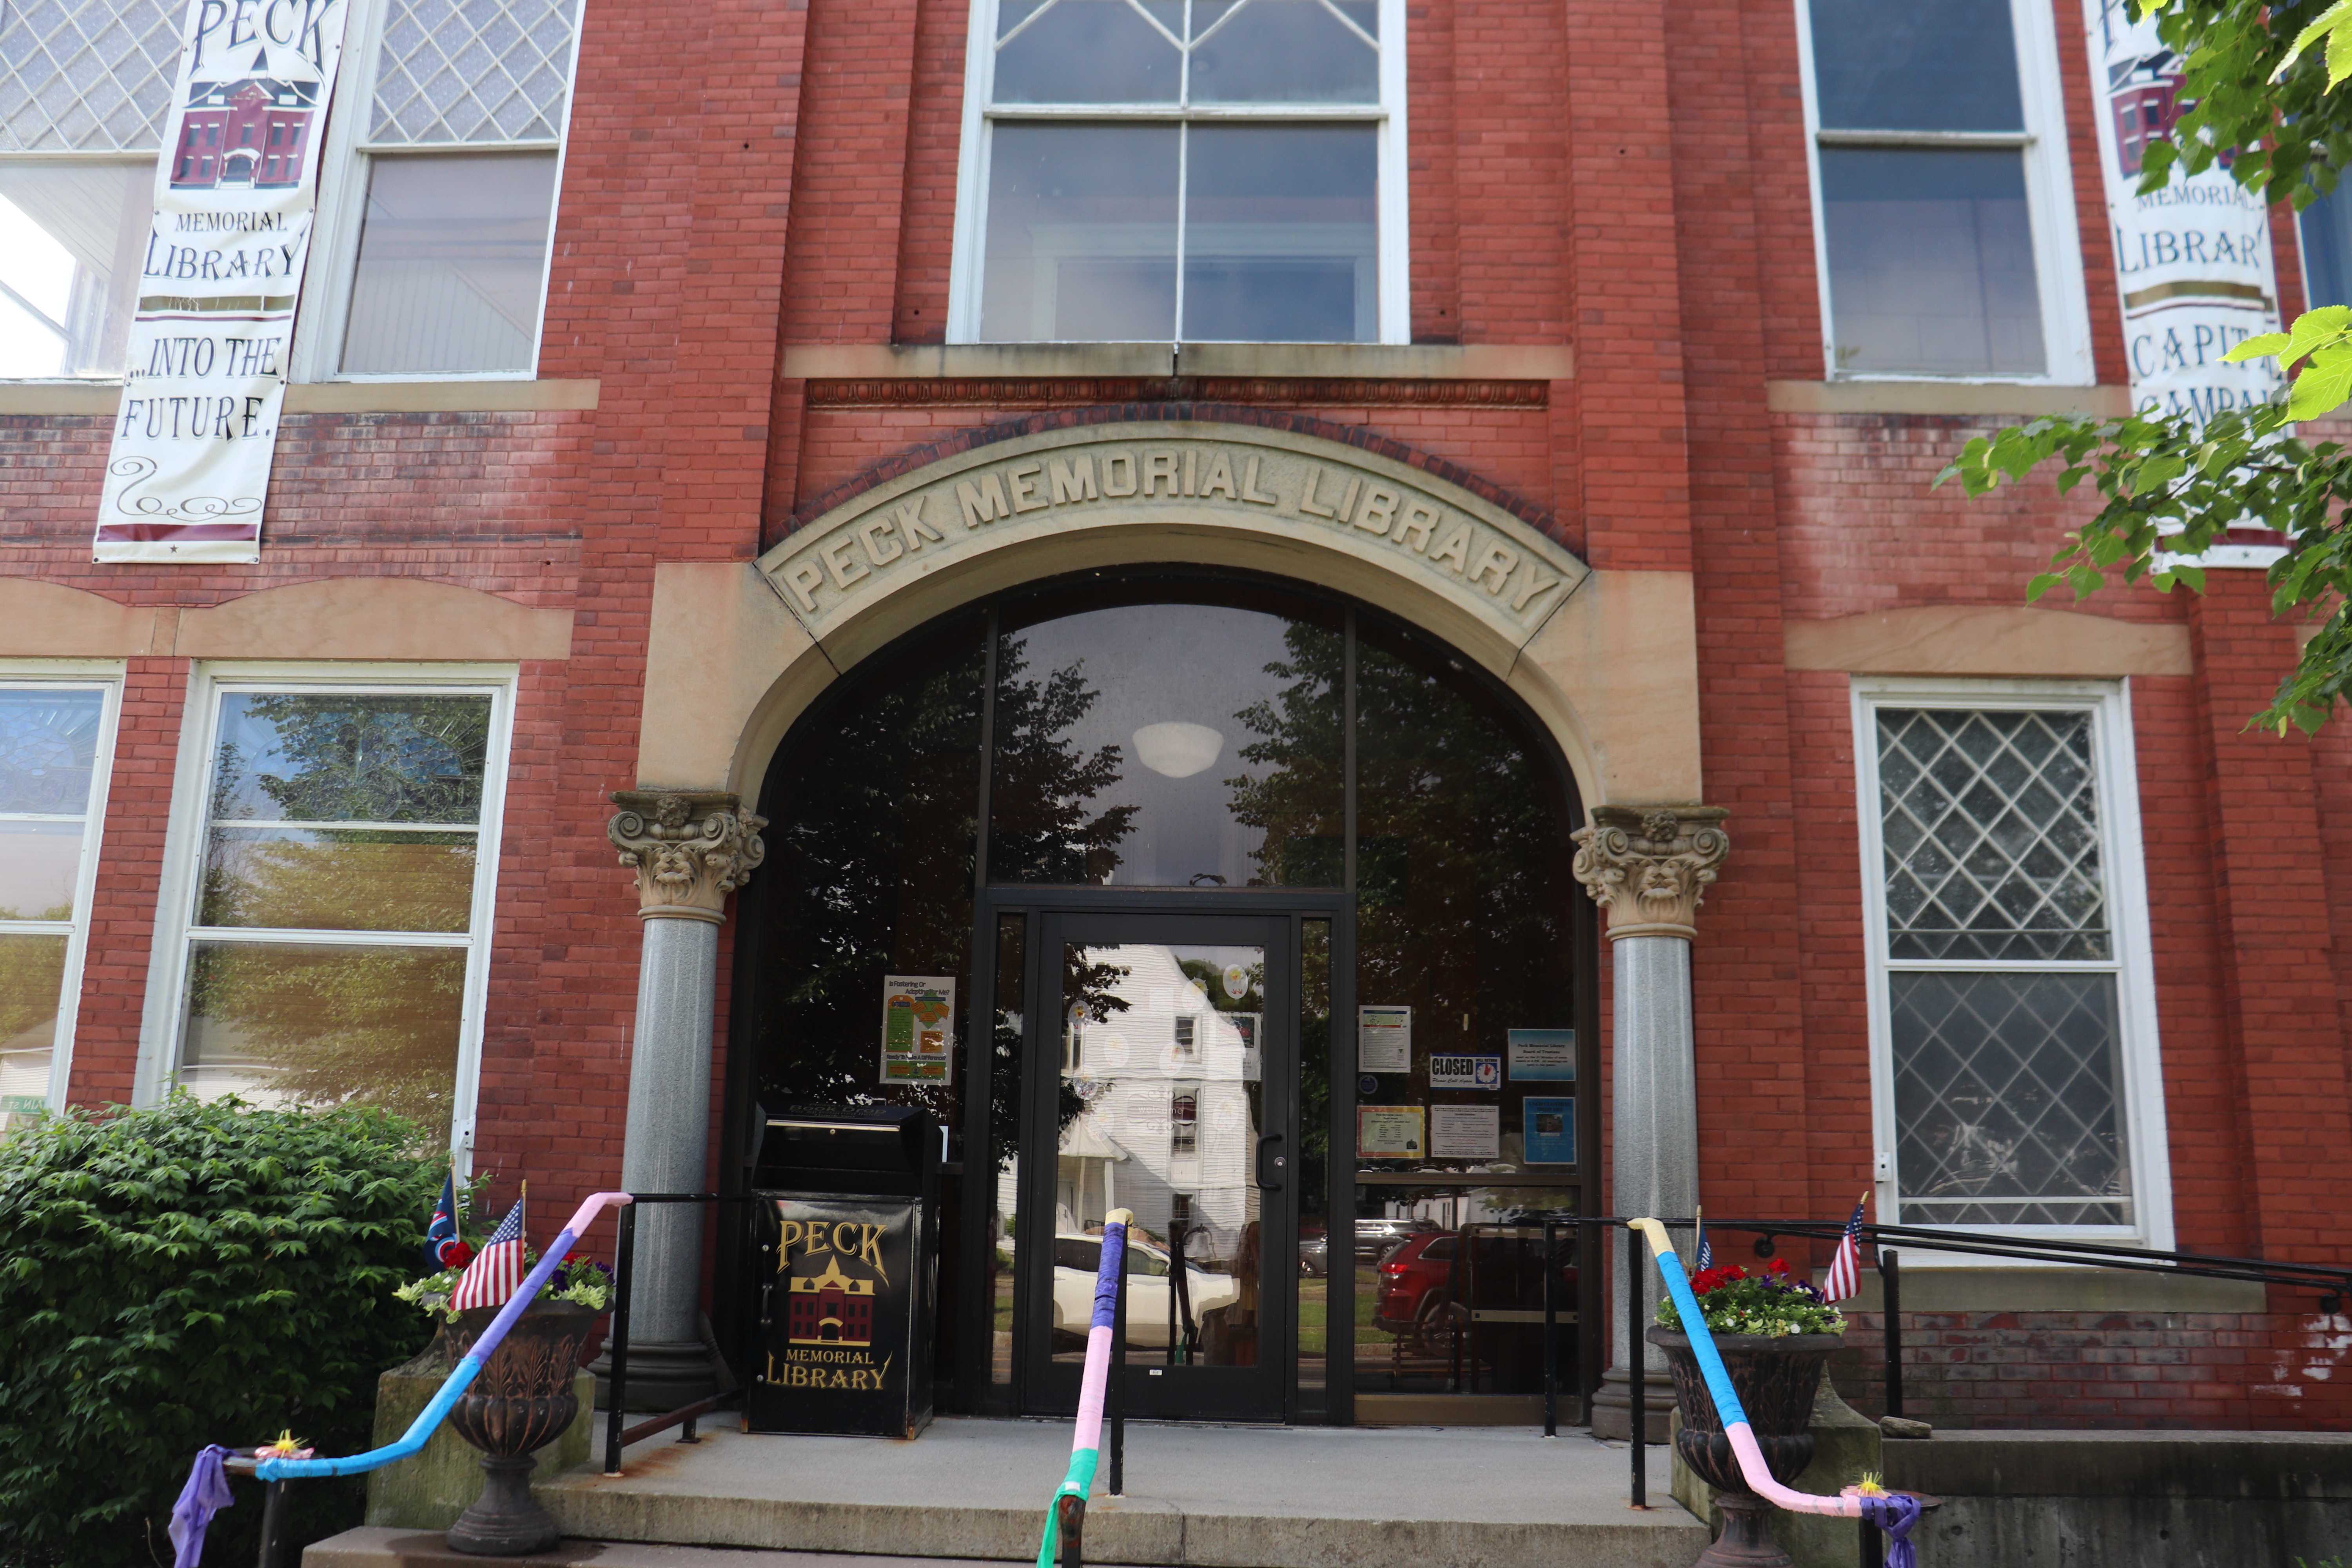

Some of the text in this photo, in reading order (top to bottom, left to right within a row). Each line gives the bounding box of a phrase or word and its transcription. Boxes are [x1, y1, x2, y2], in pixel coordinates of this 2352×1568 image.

[187, 0, 338, 94] PECK
[2137, 185, 2255, 213] MEMORIAL
[174, 212, 289, 232] MEMORIAL
[143, 224, 309, 281] LIBRARY
[130, 337, 282, 379] ...INTO THE
[120, 396, 271, 443] FUTURE.
[784, 448, 1560, 612] PECK MEMORIAL LIBRARY
[1432, 1058, 1473, 1075] CLOSED
[1138, 1105, 1183, 1114] welcome
[776, 1220, 889, 1288] PECK
[766, 1350, 893, 1391] LIBRARY
[785, 1348, 875, 1365] MEMORIAL
